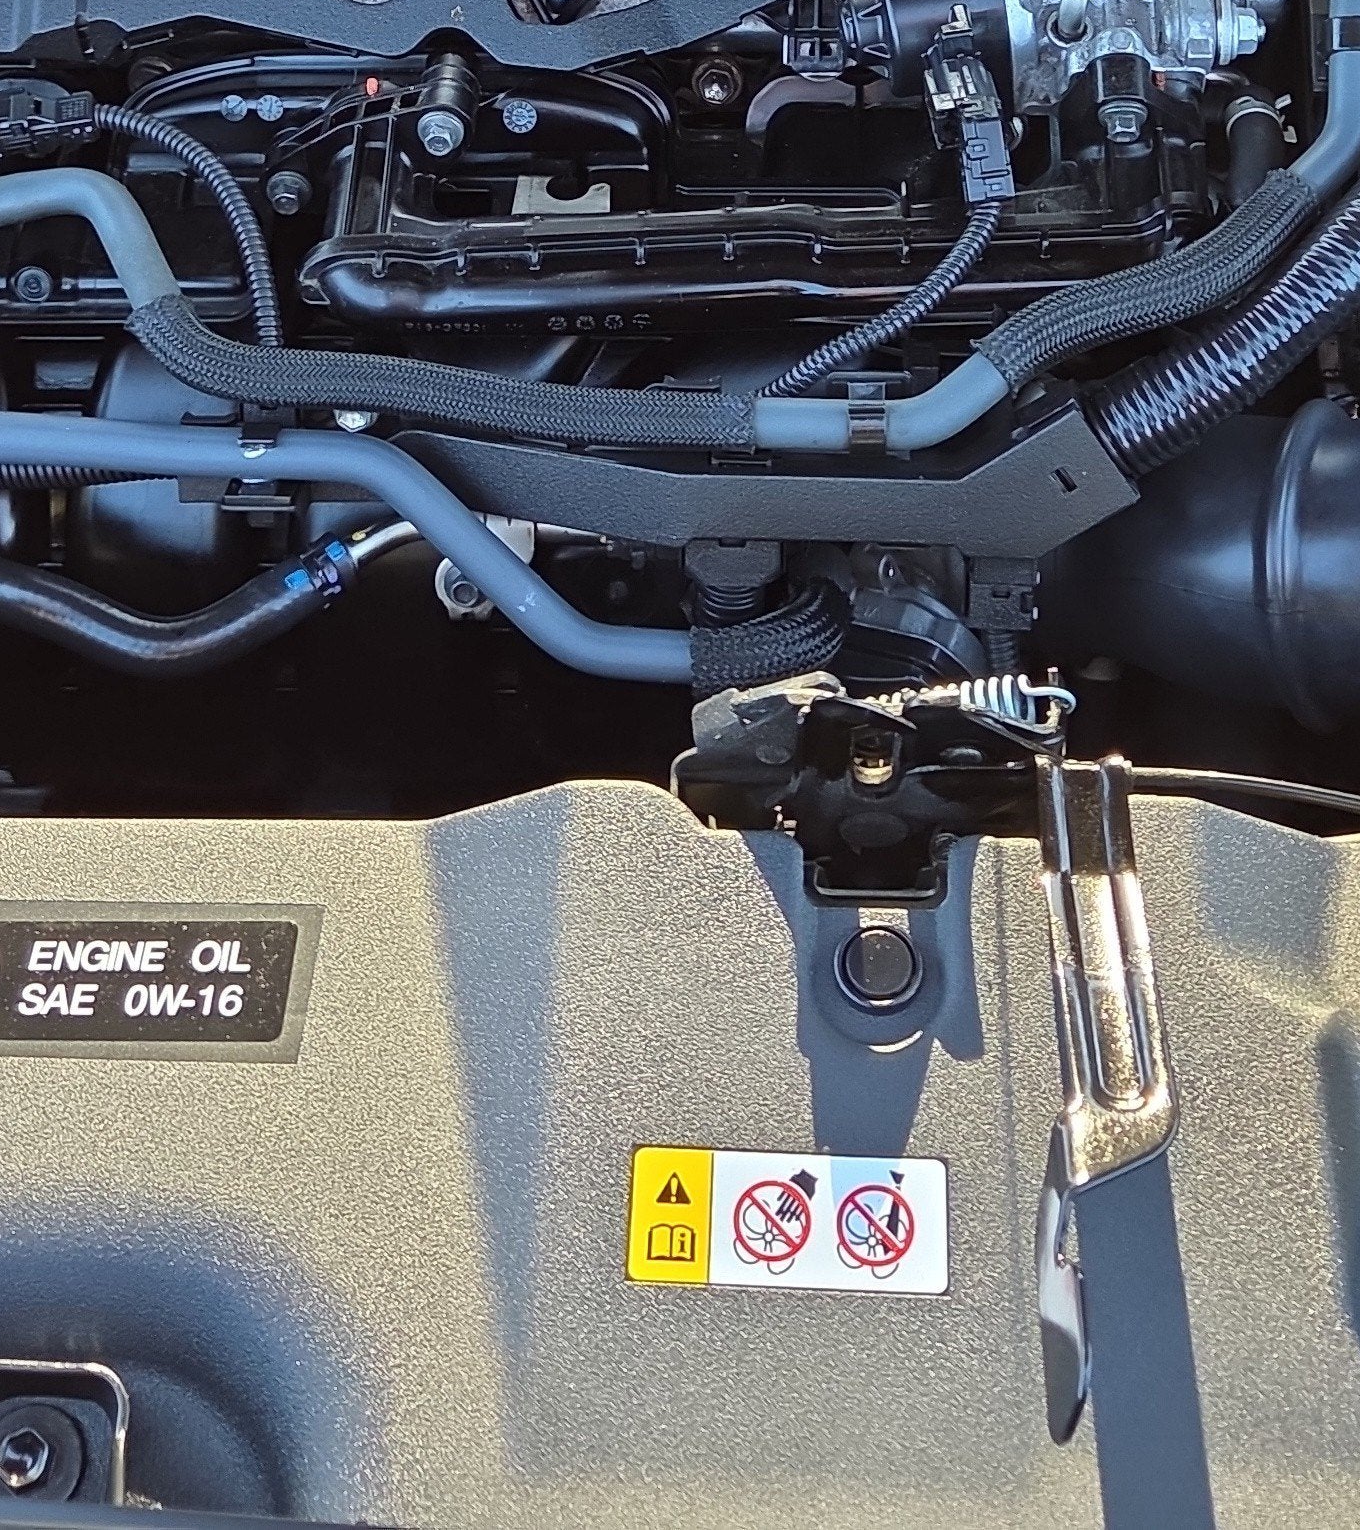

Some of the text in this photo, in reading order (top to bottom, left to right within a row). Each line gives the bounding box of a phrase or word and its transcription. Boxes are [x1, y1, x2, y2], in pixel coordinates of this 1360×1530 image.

[27, 939, 251, 973] ENGINE OIL
[17, 982, 245, 1018] SAE 0W-16
